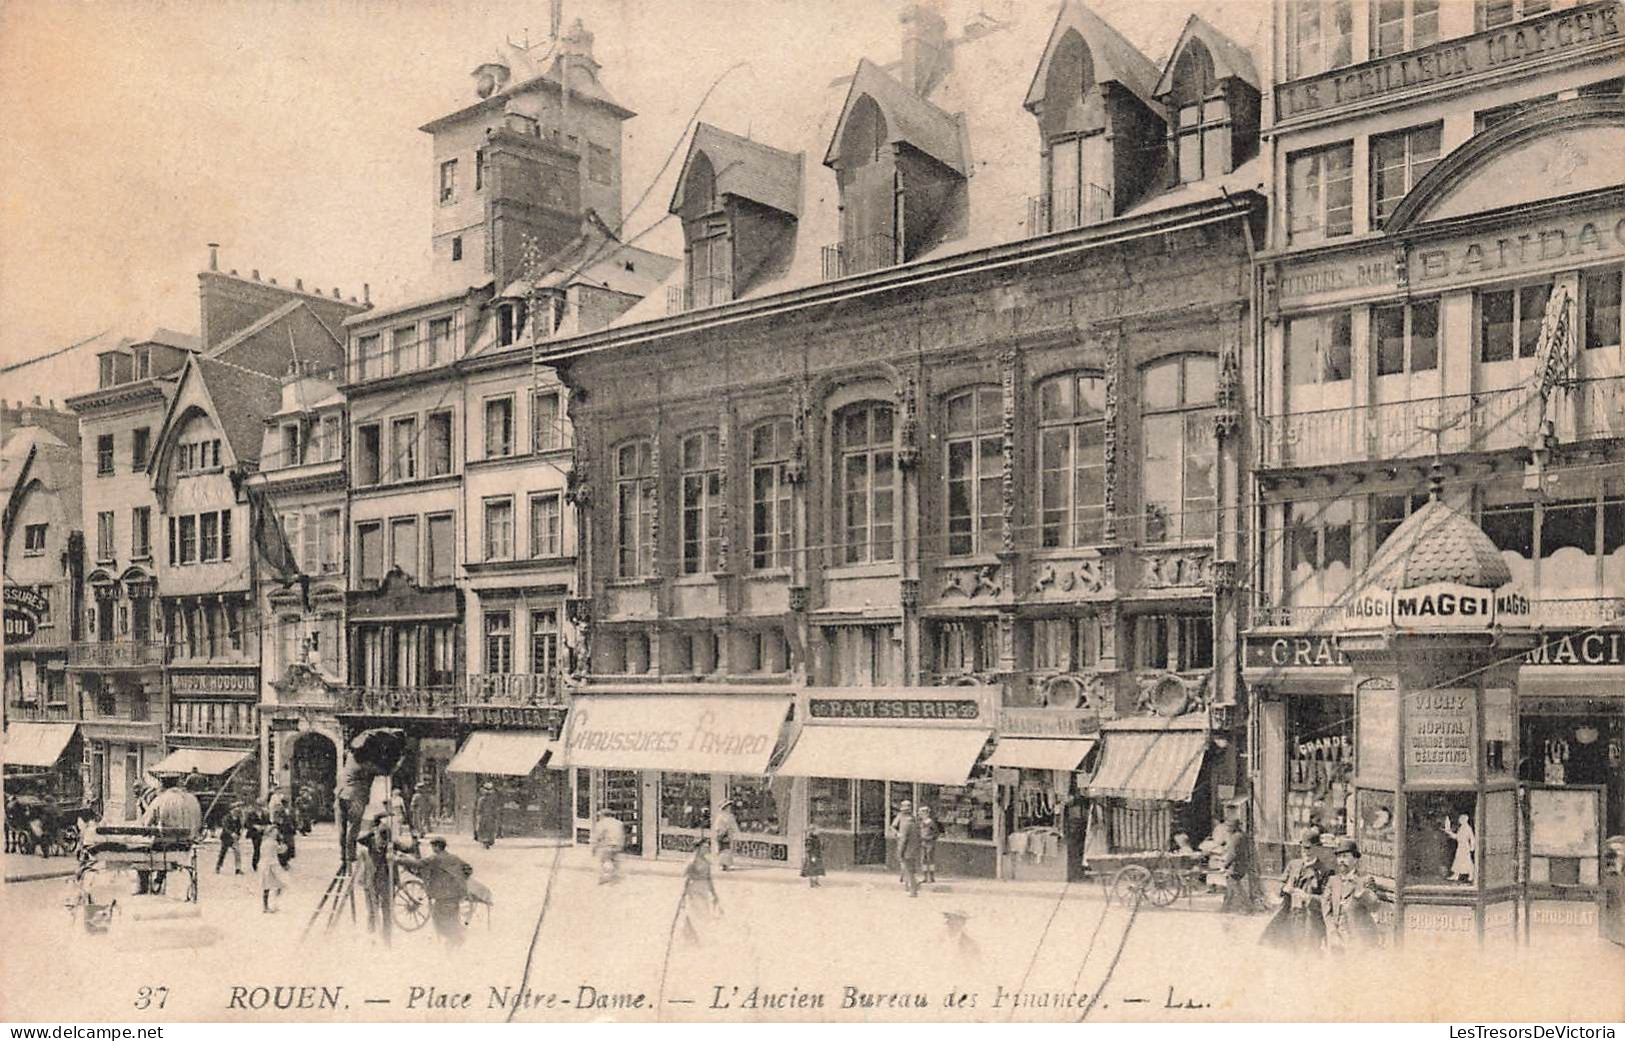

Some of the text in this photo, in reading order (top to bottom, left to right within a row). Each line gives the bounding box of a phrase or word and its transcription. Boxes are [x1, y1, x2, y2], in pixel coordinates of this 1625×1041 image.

[1346, 597, 1389, 618] MAGGI
[1399, 593, 1489, 617] MAGGI
[1498, 593, 1531, 615] MAGGI
[829, 701, 955, 718] PATISSERIE
[1415, 695, 1468, 710] VICHY
[569, 708, 683, 751] CHAUSSURES
[1300, 735, 1349, 755] GRANDE
